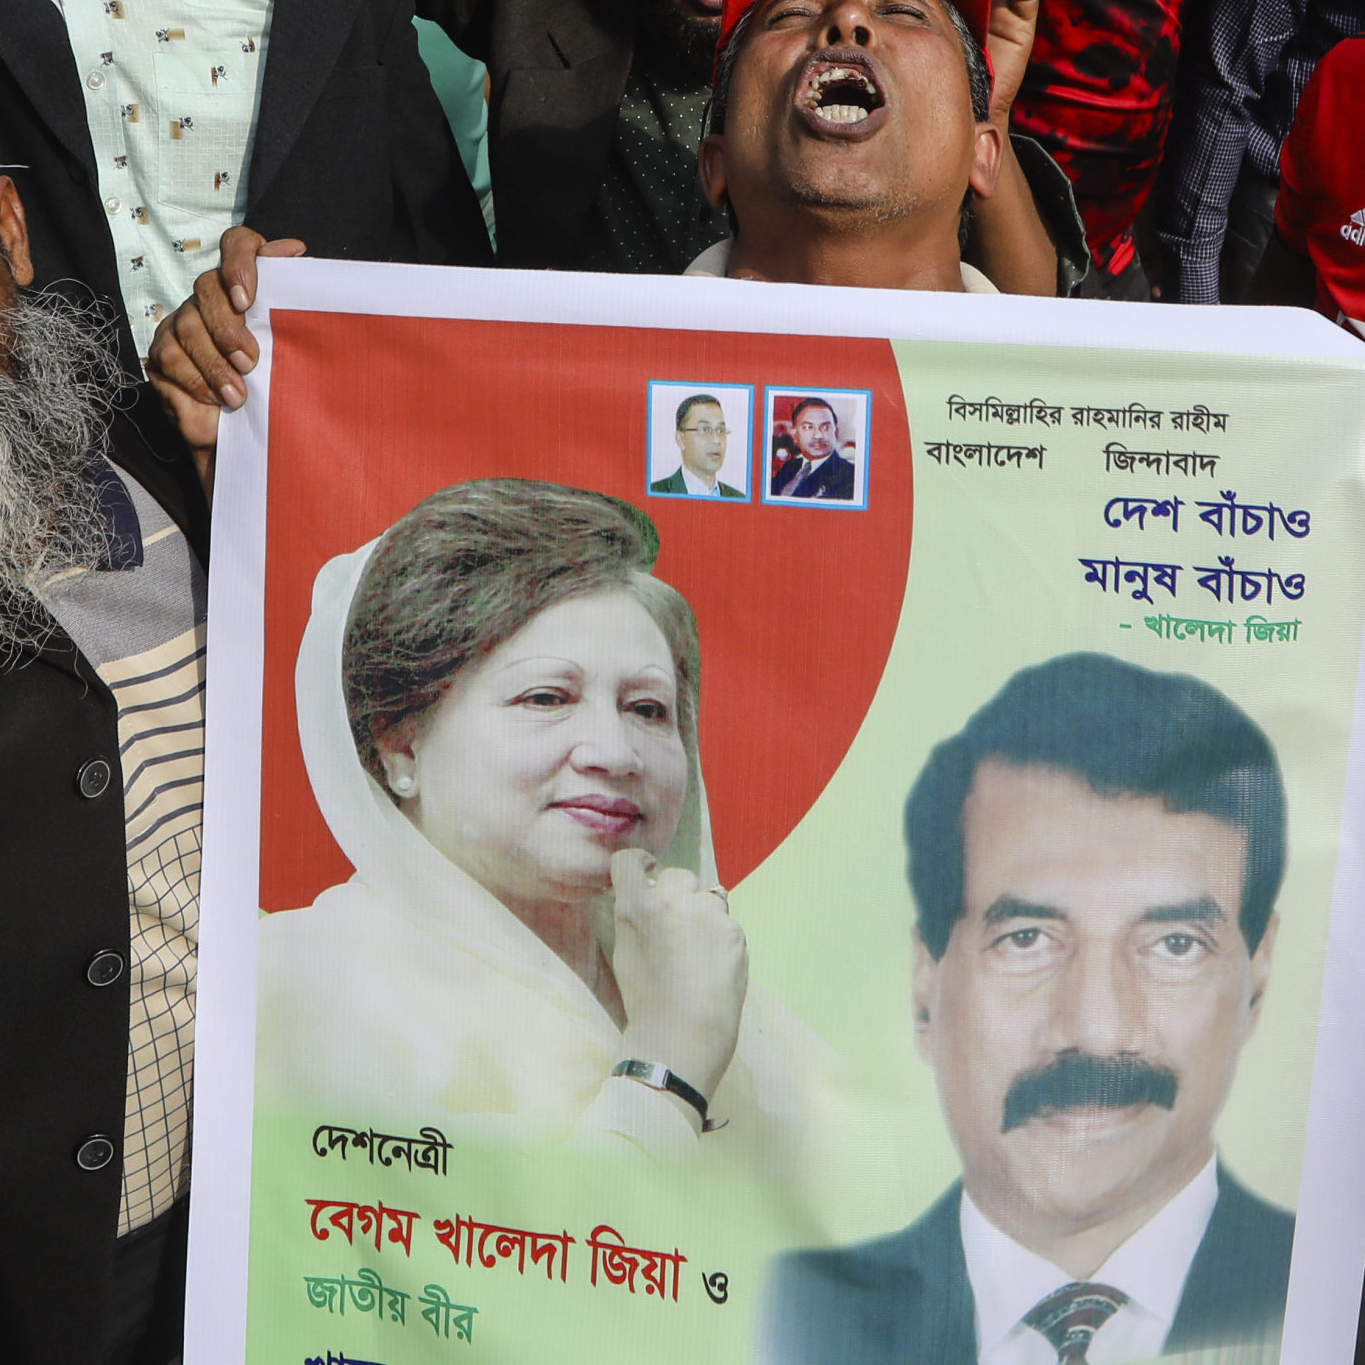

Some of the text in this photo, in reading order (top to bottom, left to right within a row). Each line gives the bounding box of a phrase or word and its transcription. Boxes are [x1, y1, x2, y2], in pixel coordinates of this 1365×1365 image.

[946, 394, 1230, 434] বিসমিল্লাহির রাহমানির রাহীম
[924, 440, 1221, 478] বাংলাদেশ জিন্দাবাদ
[1104, 490, 1311, 541] দেশ বাঁচাও
[1078, 556, 1306, 605] মানুষ বাঁচাও
[1144, 613, 1236, 645] খালেদা
[1244, 615, 1303, 644] জিয়া
[311, 1124, 454, 1176] দেশনেত্রী
[304, 1197, 729, 1305] বেগম খালেদা জিয়া ও
[303, 1266, 480, 1345] জাতীয় বীর
